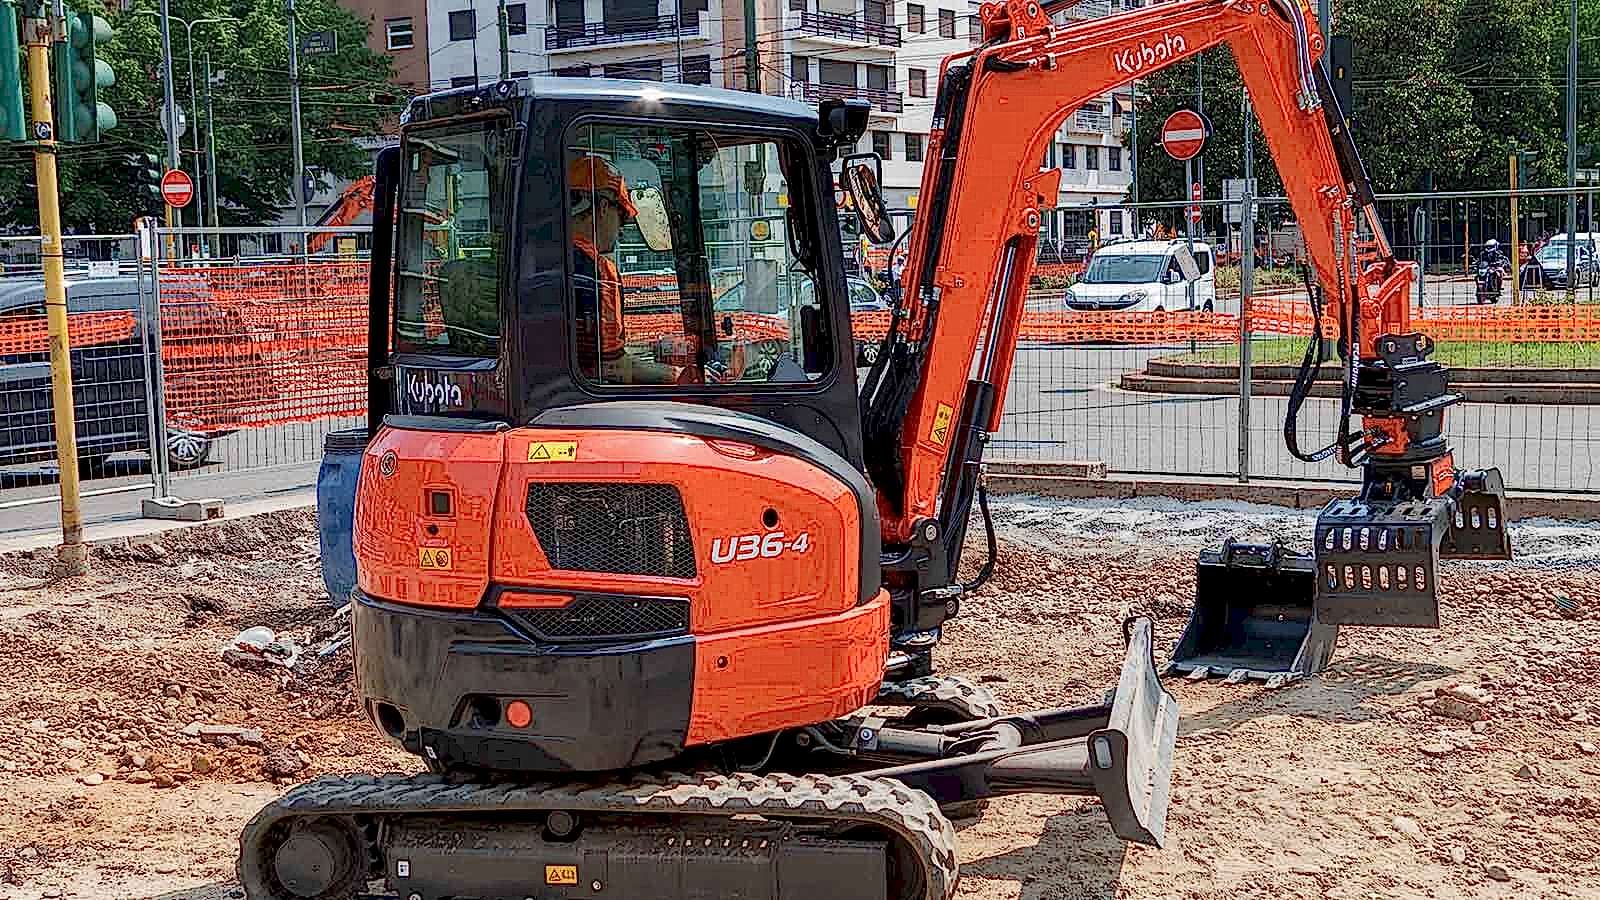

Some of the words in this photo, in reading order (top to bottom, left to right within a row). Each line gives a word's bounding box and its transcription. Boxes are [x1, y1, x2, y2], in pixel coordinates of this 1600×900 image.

[1114, 33, 1186, 73] Kubota
[406, 373, 463, 406] Kubota
[711, 531, 809, 564] U36-4
